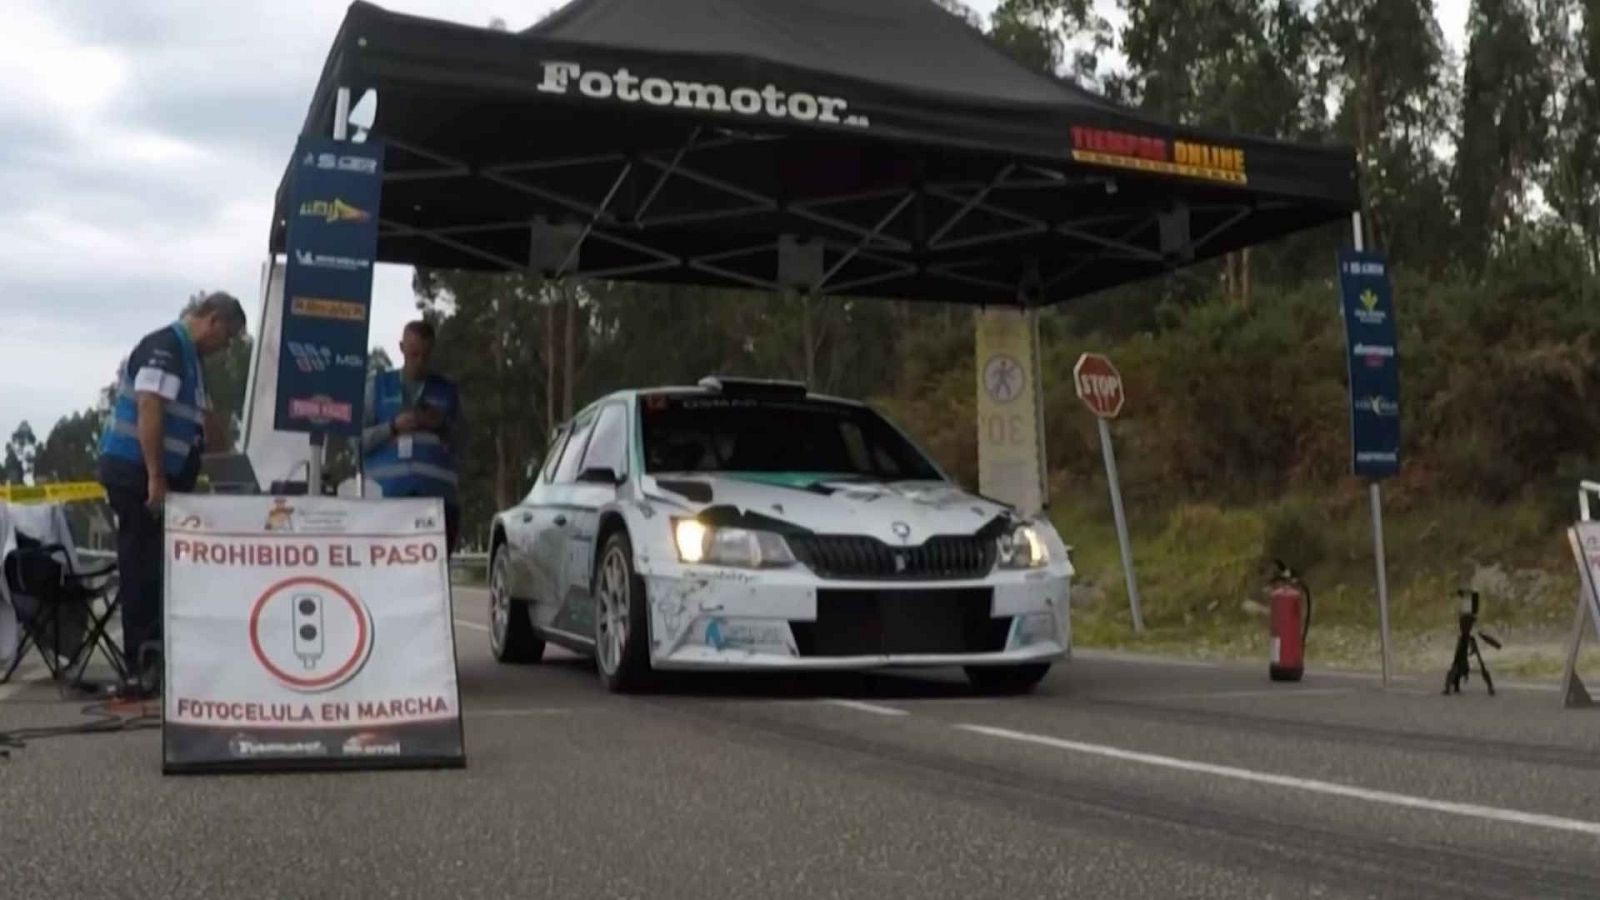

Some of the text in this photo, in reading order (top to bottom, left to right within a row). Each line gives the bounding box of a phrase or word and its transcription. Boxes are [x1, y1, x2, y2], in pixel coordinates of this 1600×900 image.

[1174, 141, 1246, 172] ONLINE
[1080, 374, 1120, 398] STOP
[174, 539, 438, 567] PROHIBIDO EL PASO
[177, 696, 449, 722] FOTOCELULA EN MARCHA
